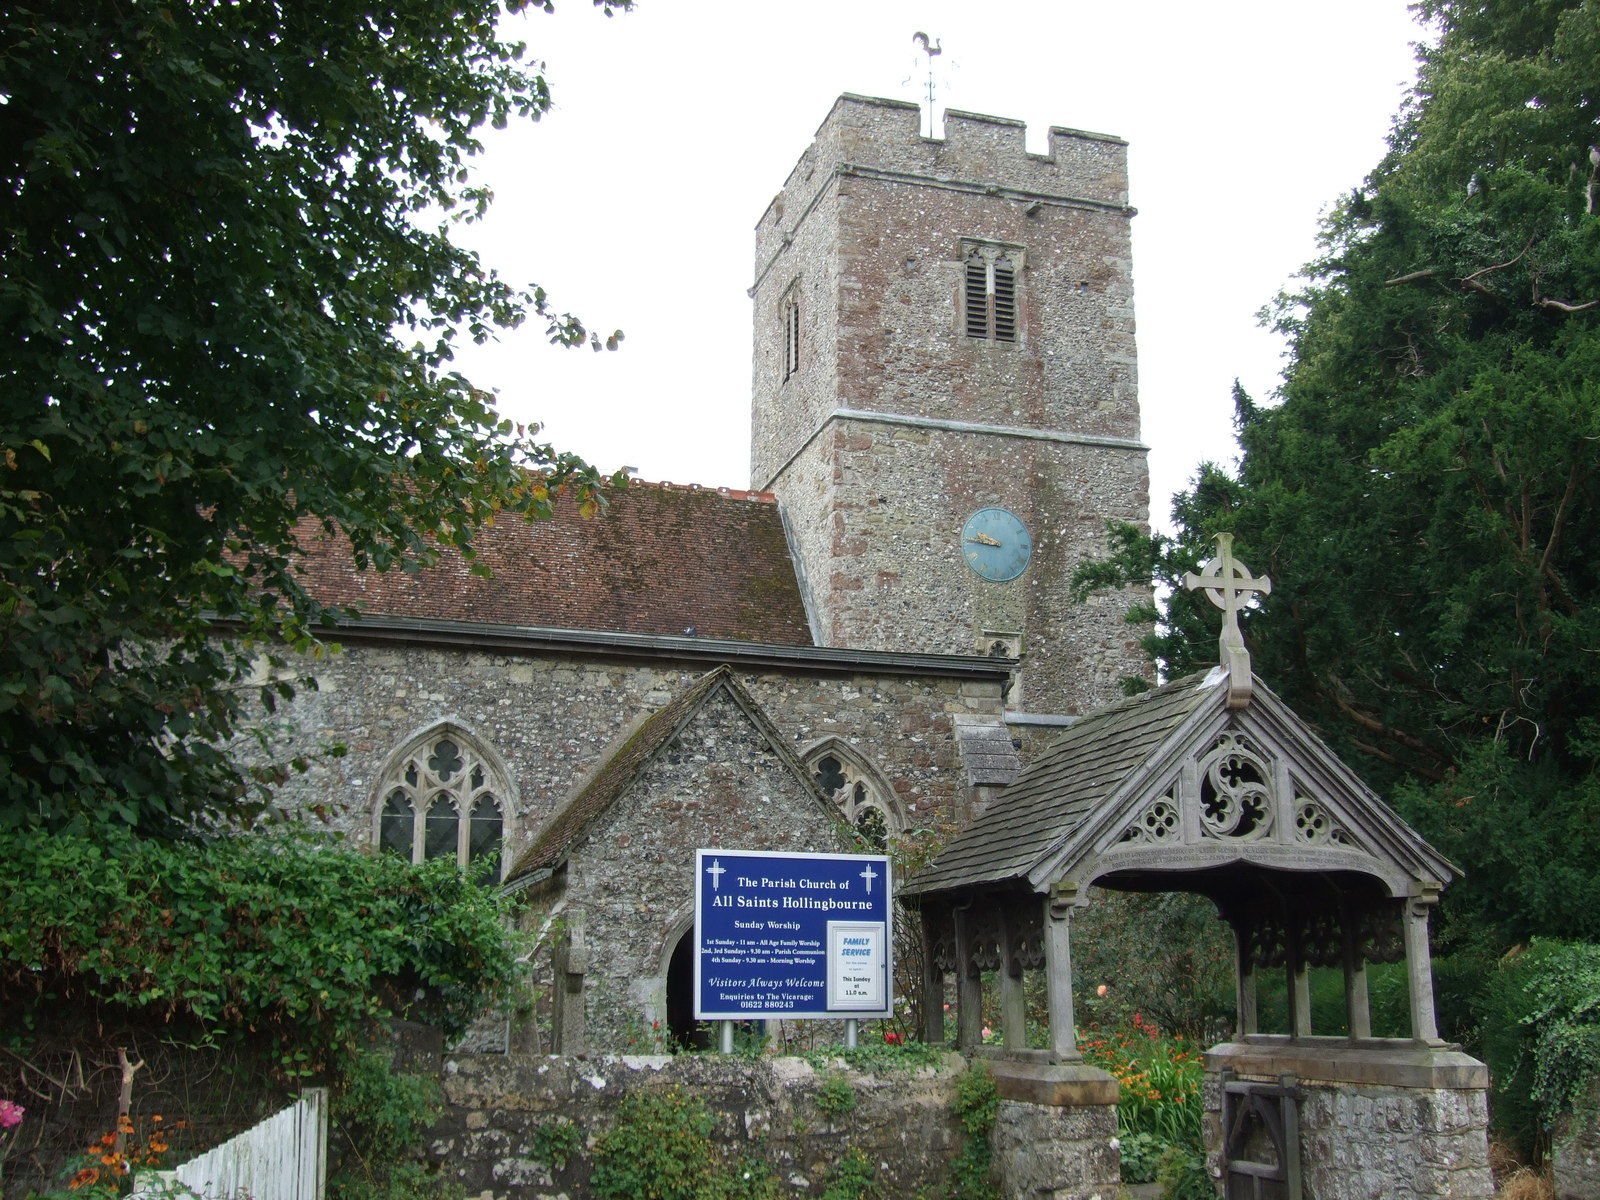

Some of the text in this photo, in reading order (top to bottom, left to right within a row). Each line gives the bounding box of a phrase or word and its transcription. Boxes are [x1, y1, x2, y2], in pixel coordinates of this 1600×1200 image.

[737, 877, 849, 890] The Parish Church of
[713, 896, 872, 911] All Saints Hollingbourne
[735, 921, 800, 930] Sunday Worship
[709, 978, 825, 989] Visitors Always Welcome
[720, 993, 754, 1001] Enquiries
[782, 994, 813, 1002] Vicarage:
